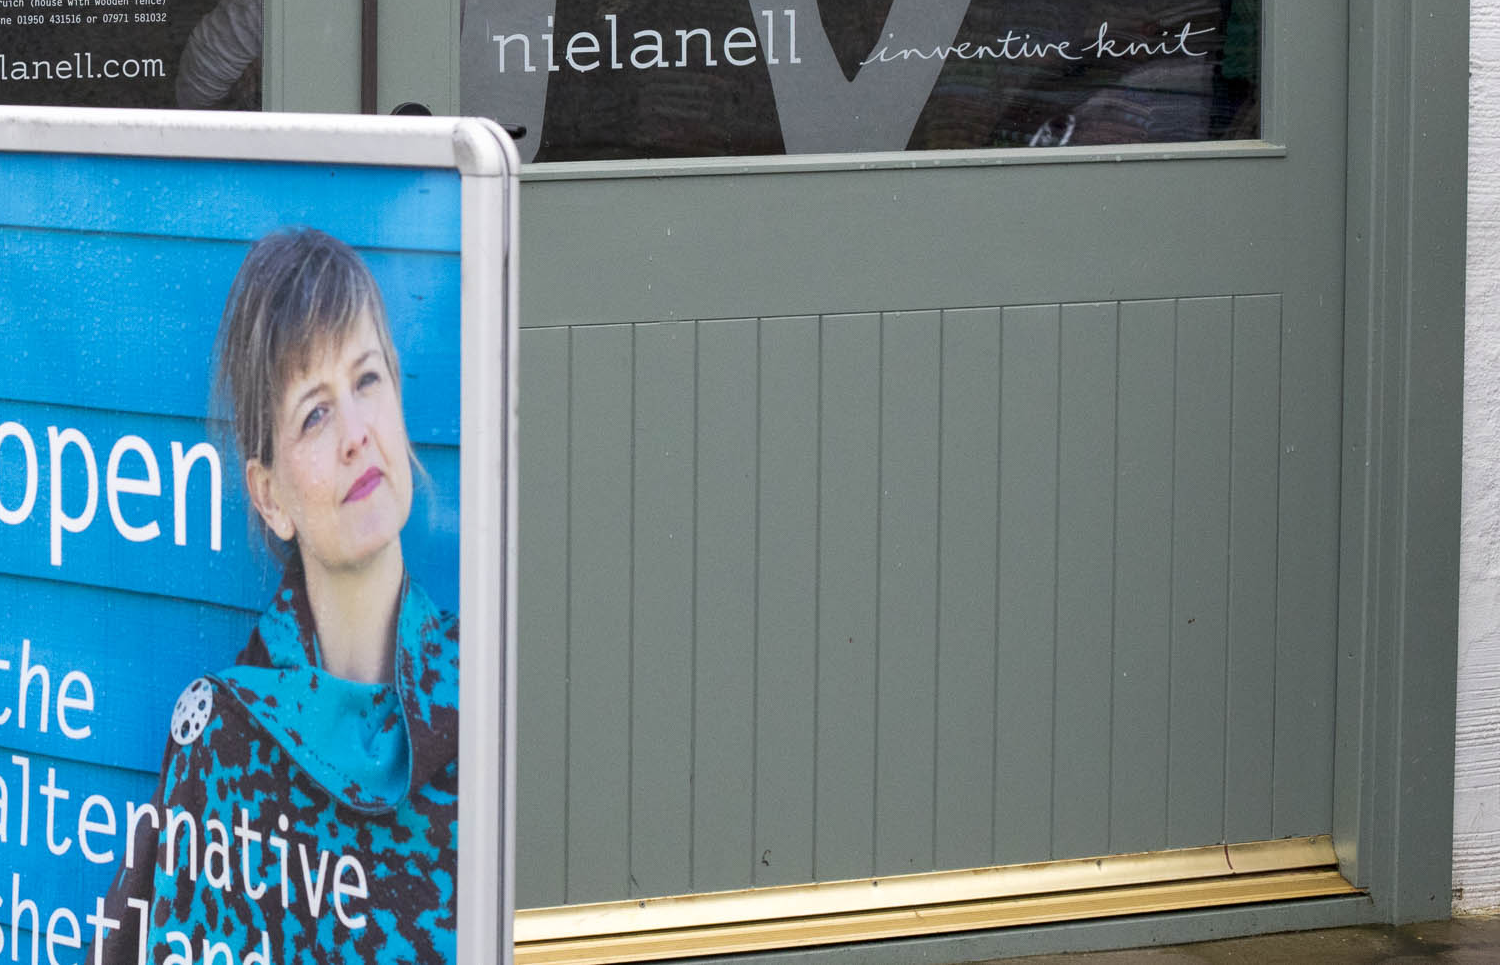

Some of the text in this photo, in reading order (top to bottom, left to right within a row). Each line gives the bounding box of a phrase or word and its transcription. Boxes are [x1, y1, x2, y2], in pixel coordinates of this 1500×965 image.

[16, 15, 45, 25] 01950
[49, 15, 82, 24] 431516
[86, 16, 98, 24] or
[102, 14, 129, 23] 07971
[134, 13, 167, 23] 581032
[492, 9, 802, 75] nielanell
[860, 20, 1217, 67] inventive knit
